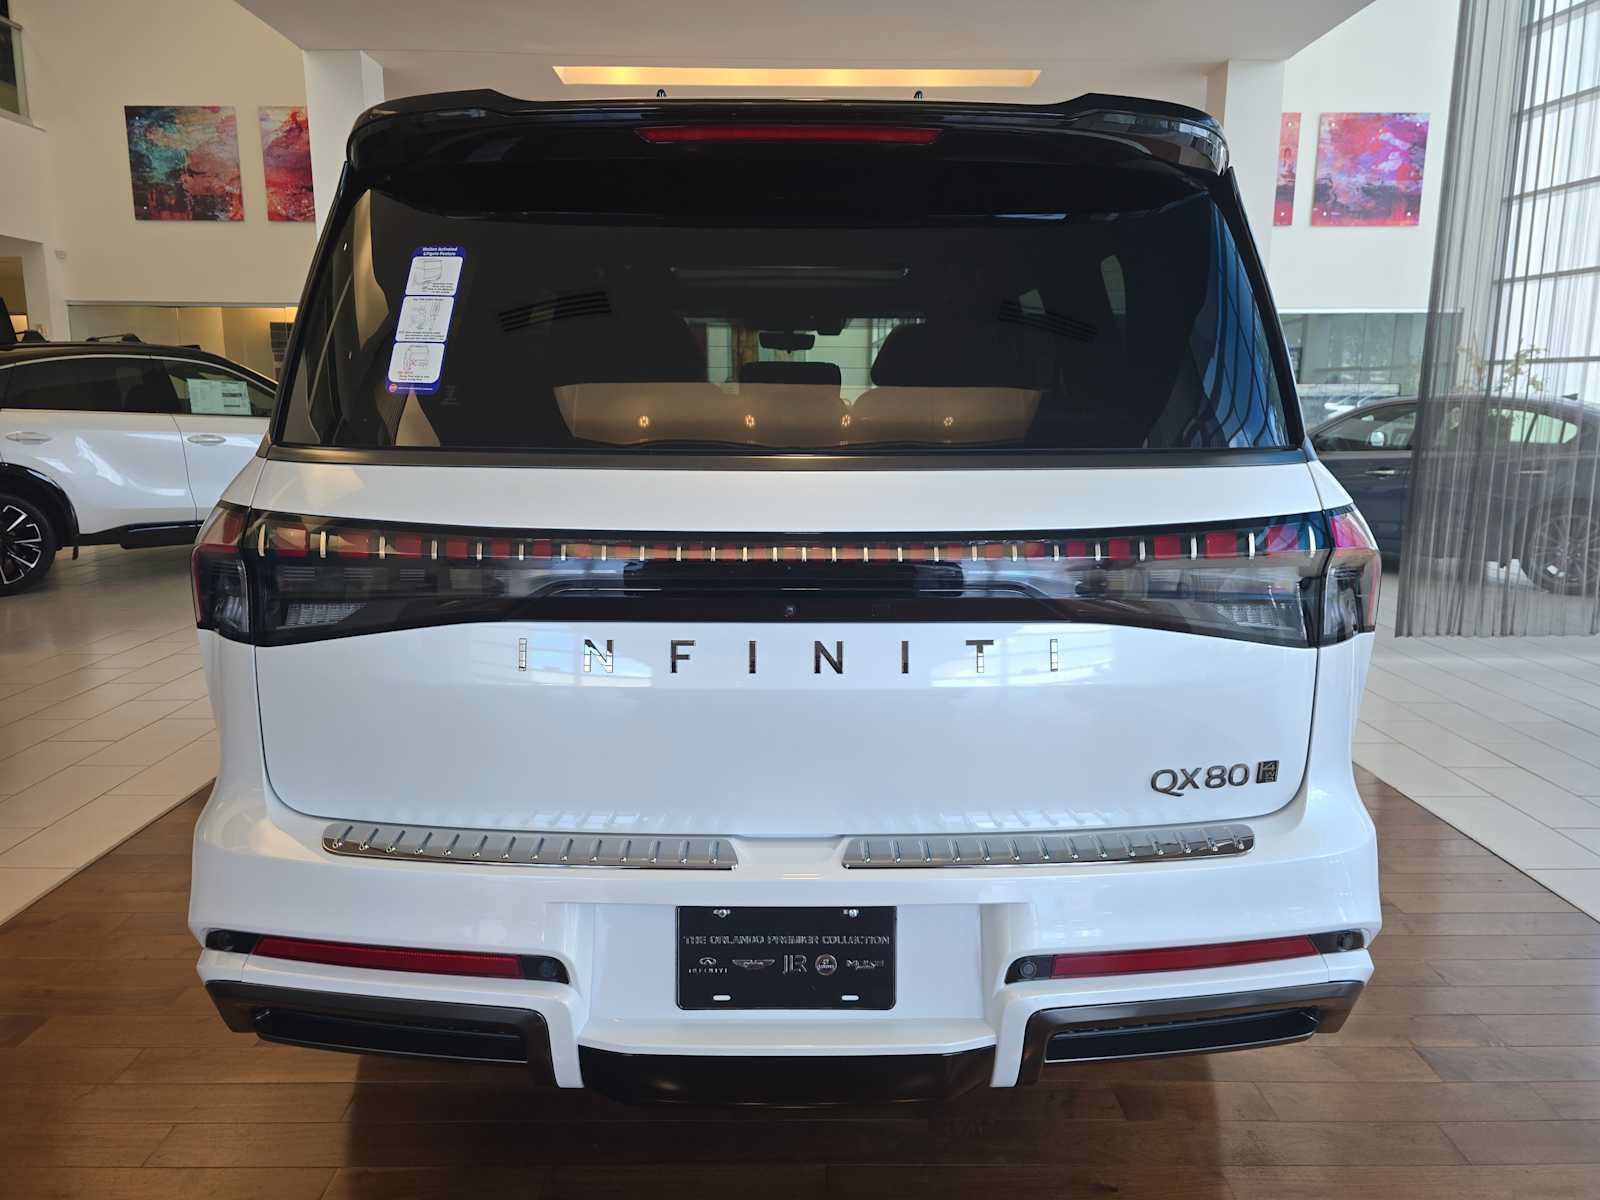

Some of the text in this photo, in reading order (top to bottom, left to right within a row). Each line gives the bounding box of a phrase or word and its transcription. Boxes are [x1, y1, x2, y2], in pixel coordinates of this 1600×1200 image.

[518, 638, 1058, 675] INFINITI
[1150, 762, 1250, 797] QX80
[683, 935, 890, 945] THE ORLANDO PREMIER COLLECTION
